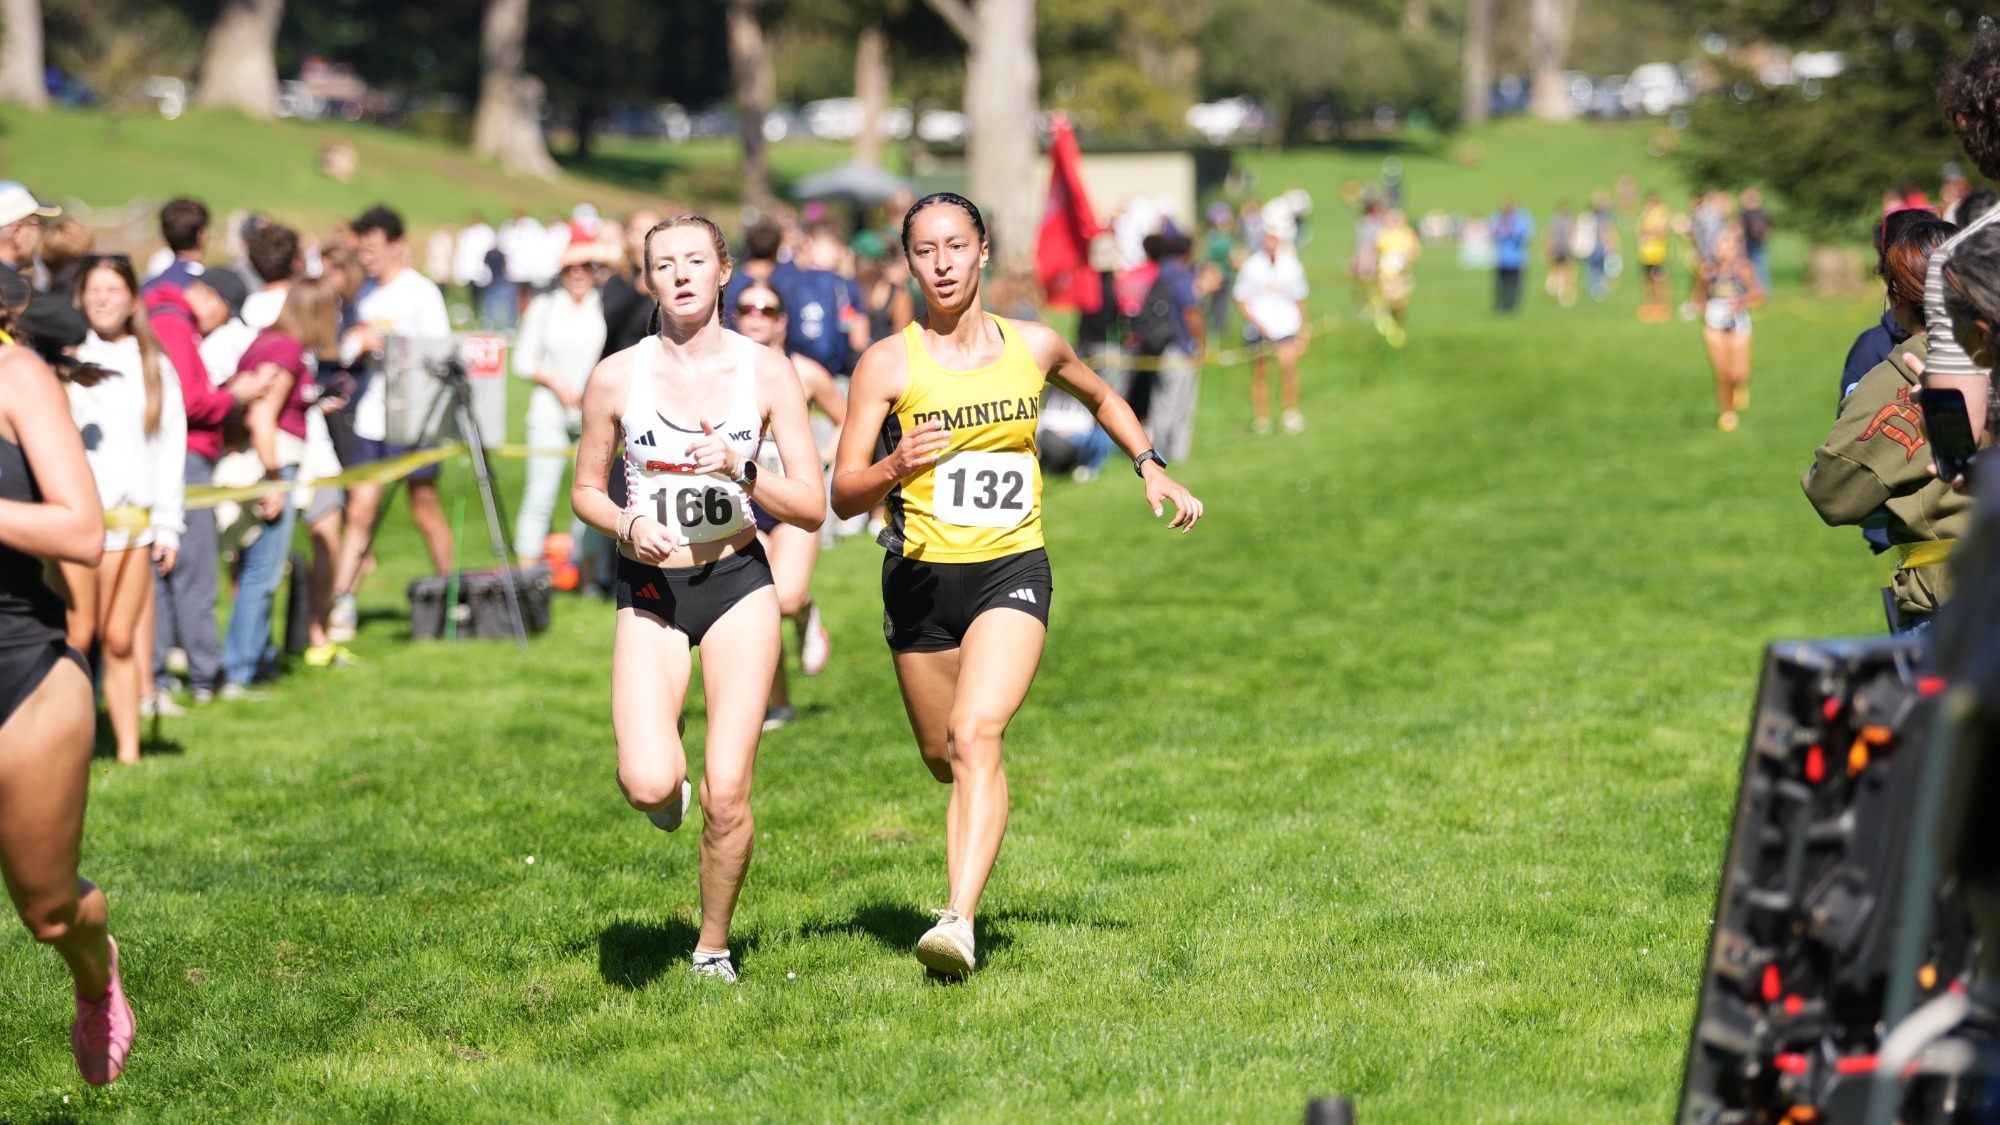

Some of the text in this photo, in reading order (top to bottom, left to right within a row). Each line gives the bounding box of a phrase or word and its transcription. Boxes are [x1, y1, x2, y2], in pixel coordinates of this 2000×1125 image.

[728, 429, 752, 442] WCC
[650, 486, 733, 527] 166
[947, 467, 1024, 510] 132
